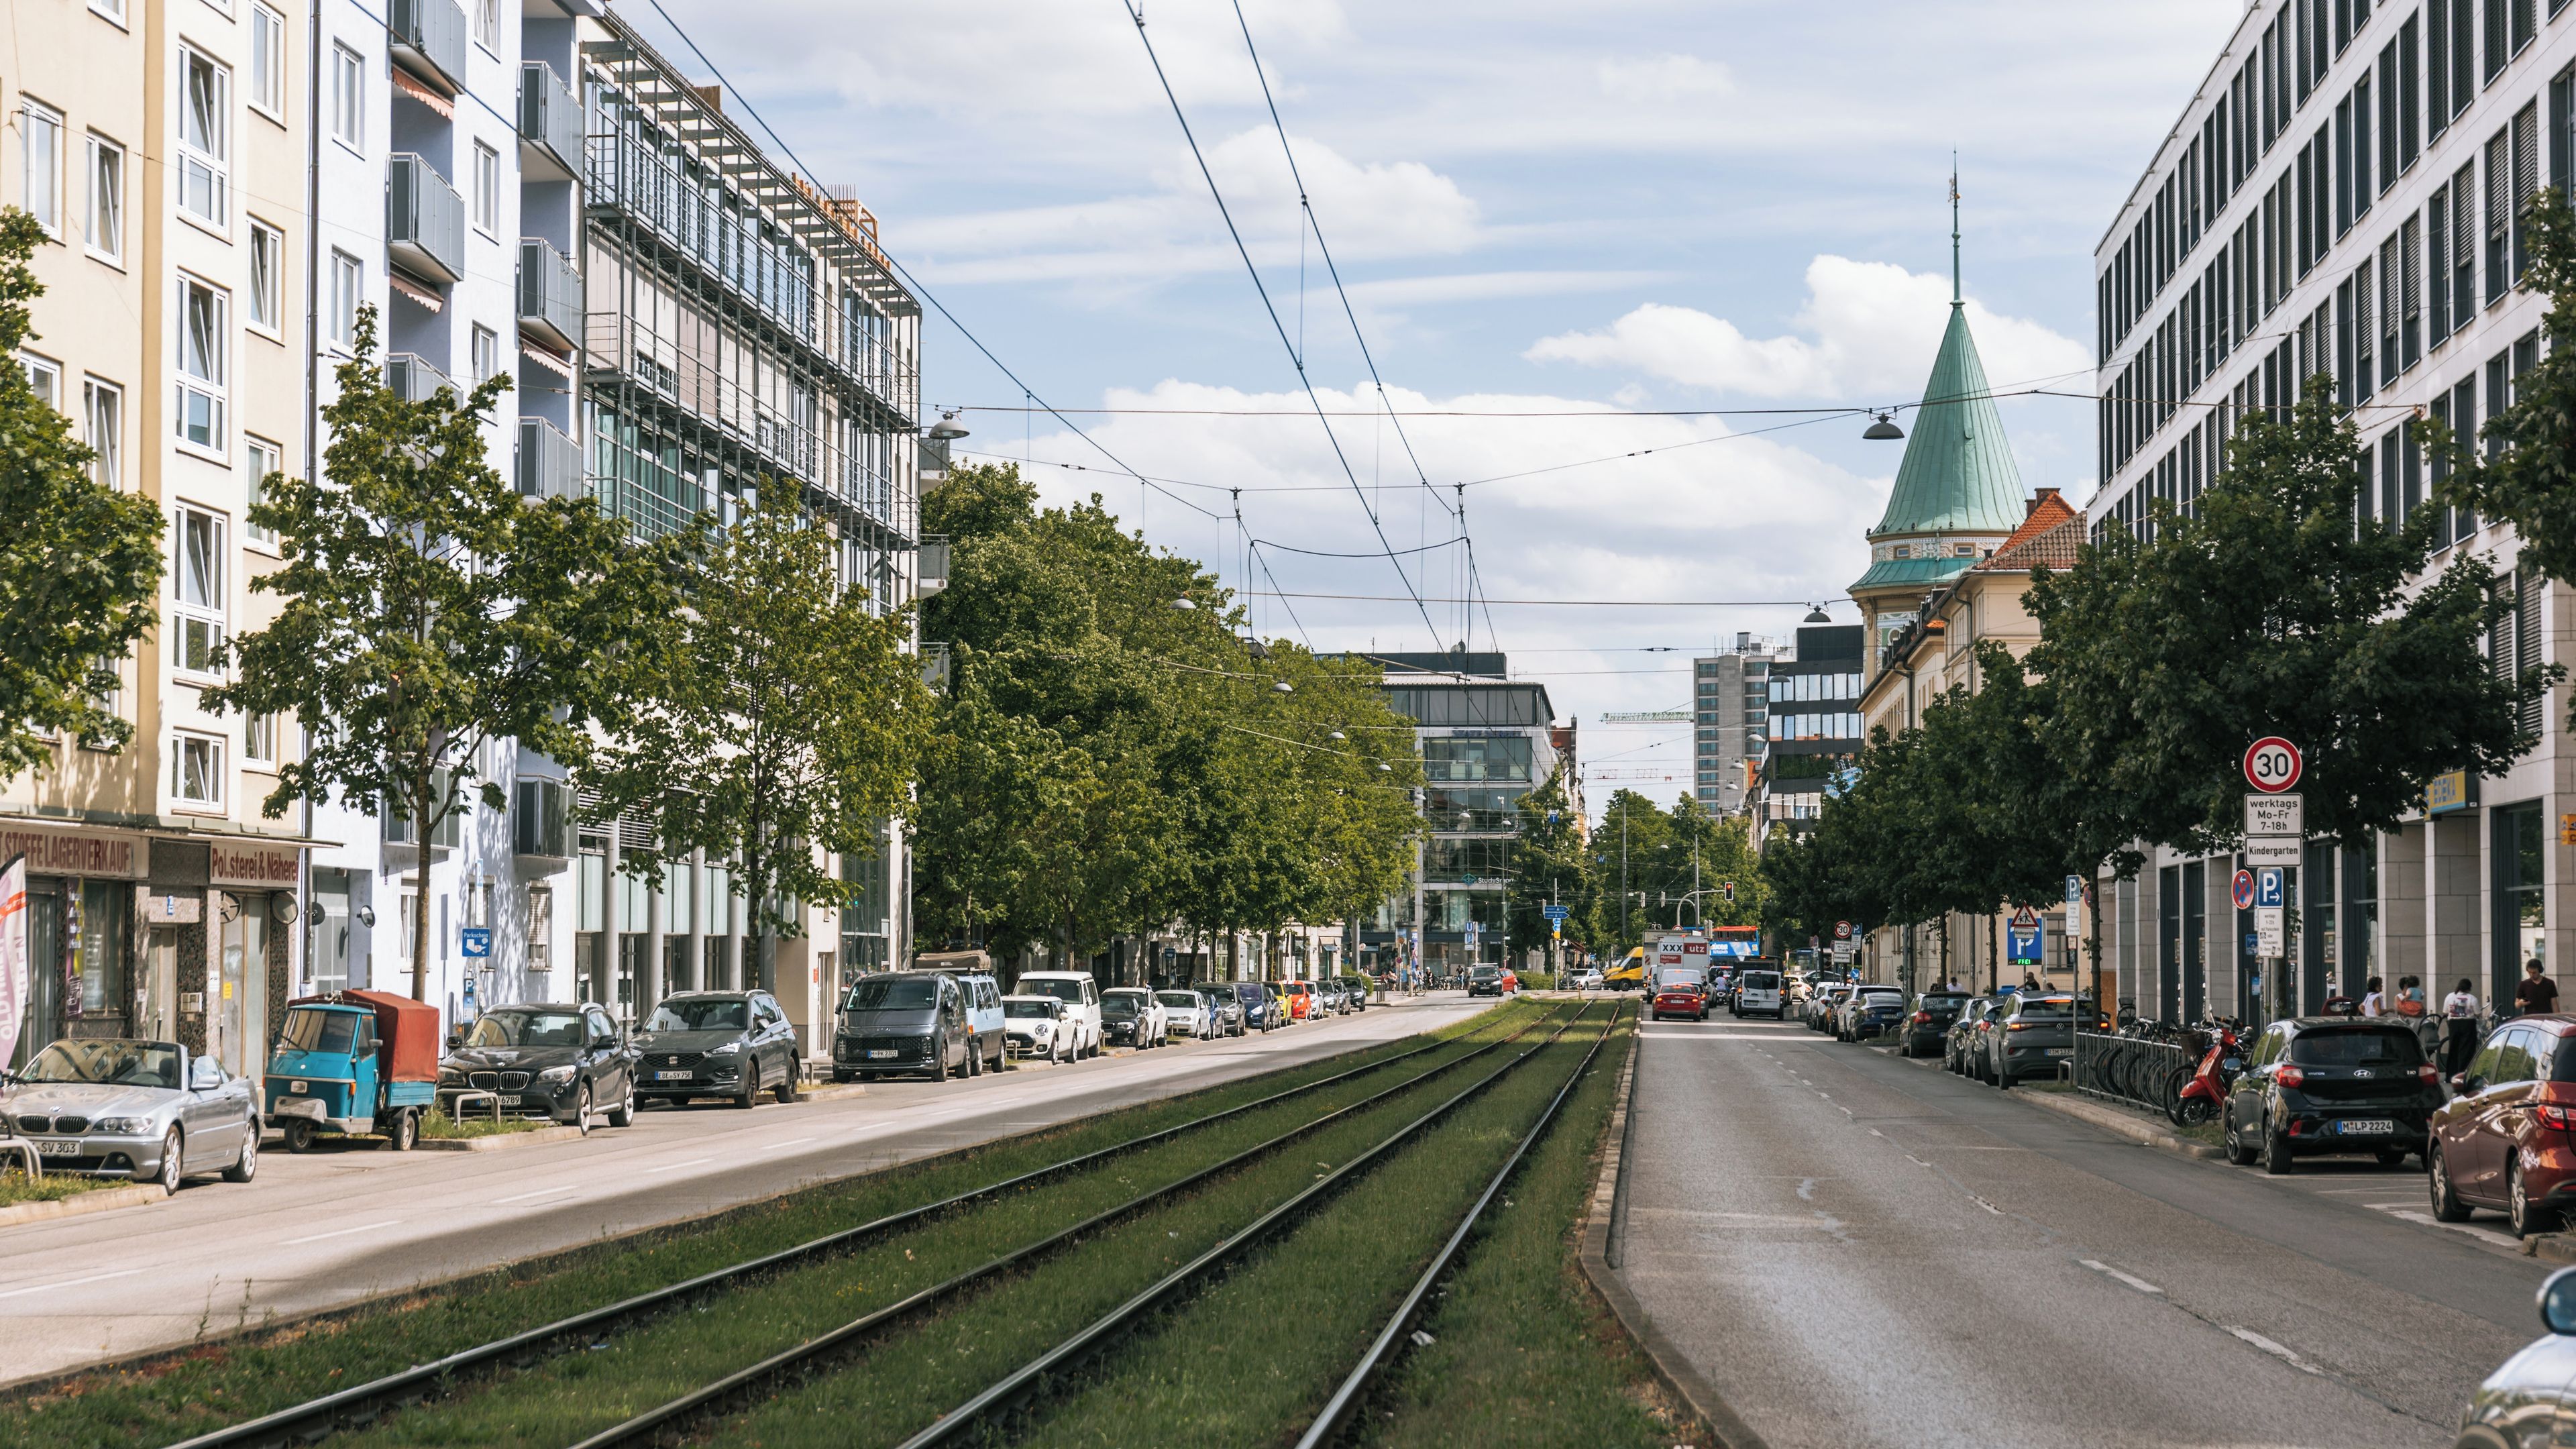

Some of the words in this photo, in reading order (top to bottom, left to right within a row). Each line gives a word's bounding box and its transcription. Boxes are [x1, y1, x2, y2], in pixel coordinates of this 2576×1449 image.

[2257, 753, 2288, 777] 30
[2249, 798, 2298, 810] werktags
[2257, 810, 2289, 819] Mo-Fr
[2261, 822, 2287, 830] 7-18h
[5, 831, 44, 867] STOFFE
[45, 835, 129, 872] LAGERVERKAUF
[2249, 846, 2298, 857] Kindergarten
[258, 851, 265, 880] &
[267, 851, 299, 881] Näherei
[2069, 879, 2077, 899] P
[2263, 873, 2277, 902] P
[501, 1095, 520, 1104] 6789
[2343, 1122, 2349, 1131] M
[2355, 1122, 2367, 1130] LP
[2369, 1121, 2392, 1130] 2224
[41, 1142, 54, 1152] SV
[56, 1143, 76, 1152] 303
